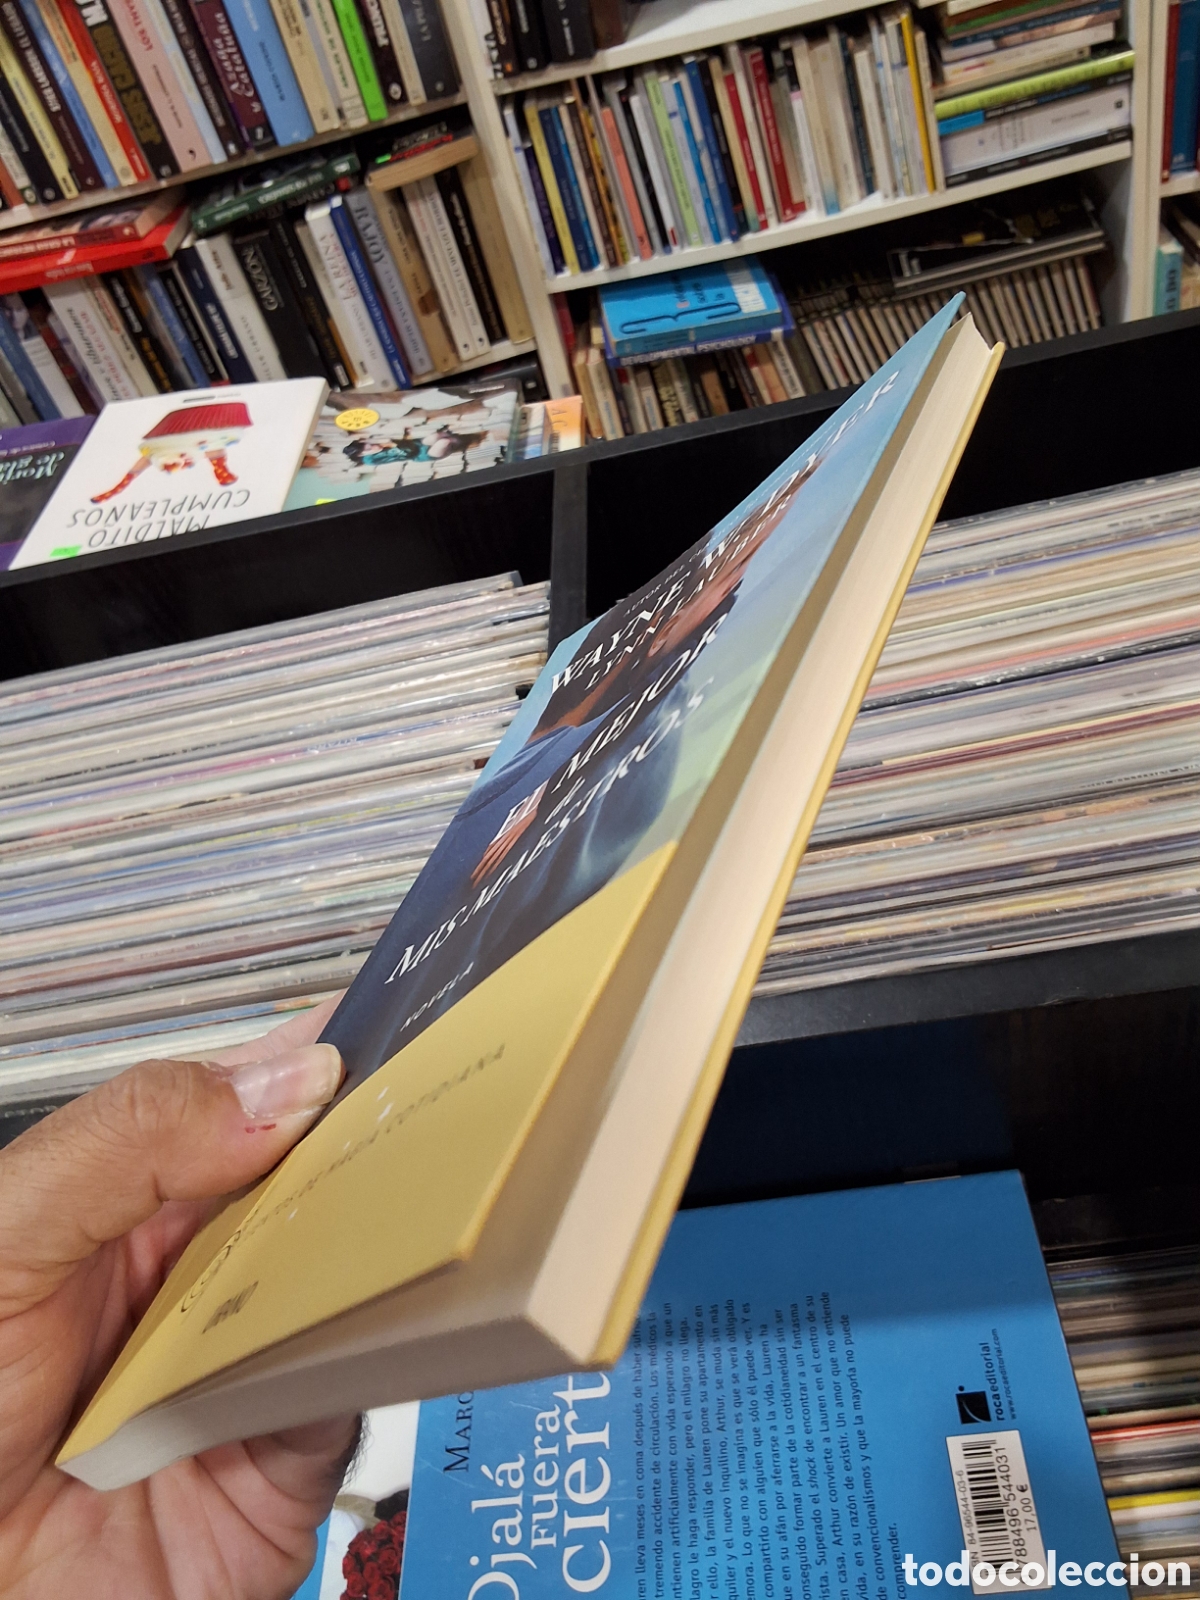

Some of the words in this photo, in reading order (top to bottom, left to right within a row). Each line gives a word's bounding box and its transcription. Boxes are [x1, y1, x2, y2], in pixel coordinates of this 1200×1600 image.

[66, 489, 251, 529] CUMPLEAÑOS
[88, 515, 211, 549] MALDITO
[551, 569, 692, 694] WAYNE
[698, 519, 747, 569] W.
[757, 370, 900, 520] DYER
[585, 614, 662, 691] LYNN
[669, 494, 793, 616] LAUBER
[489, 779, 550, 847] EL
[550, 612, 728, 794] MEJOR
[544, 776, 586, 825] de
[384, 904, 468, 985] MIS
[460, 676, 715, 927] MAESTROS
[400, 962, 474, 1033] NOVELA
[646, 1311, 656, 1321] la
[663, 1302, 671, 1315] un
[708, 1303, 718, 1323] más
[741, 1302, 750, 1313] es
[774, 1309, 783, 1323] ser
[819, 1291, 834, 1336] entiende
[663, 1318, 674, 1337] que
[677, 1316, 690, 1345] llega.
[710, 1327, 720, 1342] sin
[744, 1327, 752, 1346] ver.
[775, 1327, 785, 1342] sin
[790, 1303, 802, 1349] fantasma
[839, 1314, 854, 1345] puede
[646, 1324, 657, 1366] médicos
[681, 1348, 689, 1361] no
[827, 1339, 836, 1353] no
[845, 1349, 854, 1362] no
[711, 1346, 722, 1374] muda
[743, 1349, 758, 1381] puede
[795, 1353, 805, 1367] un
[829, 1356, 841, 1376] que
[992, 1328, 1016, 1420] www.rocaeditorial.com
[648, 1369, 658, 1388] Los
[663, 1350, 676, 1404] esperando
[680, 1365, 692, 1406] milagro
[715, 1378, 723, 1390] se
[746, 1385, 757, 1395] él
[775, 1346, 793, 1420] cotidianeidad
[846, 1366, 862, 1410] mayoría
[798, 1381, 812, 1434] encontrar
[832, 1380, 844, 1407] amor
[648, 1391, 660, 1456] circulación.
[664, 1408, 676, 1431] vida
[681, 1410, 692, 1420] el
[715, 1394, 726, 1432] Arthur,
[747, 1399, 759, 1422] sólo
[835, 1412, 846, 1428] Un
[852, 1414, 864, 1425] la
[684, 1424, 695, 1448] pero
[752, 1426, 763, 1447] que
[784, 1424, 795, 1434] la
[856, 1429, 869, 1450] que
[668, 1435, 677, 1455] con
[785, 1438, 797, 1452] de
[802, 1439, 814, 1452] de
[837, 1432, 852, 1471] existir.
[649, 1460, 660, 1474] de
[717, 1436, 731, 1492] inquilino,
[753, 1451, 767, 1494] alguien
[789, 1456, 802, 1487] parte
[804, 1456, 819, 1489] shock
[996, 1447, 1016, 1501] 544031
[551, 1371, 611, 1592] Ciert
[683, 1453, 697, 1513] responder,
[842, 1475, 854, 1490] de
[1017, 1484, 1028, 1493] €
[650, 1478, 662, 1534] accidente
[667, 1459, 680, 1546] artificialmente
[758, 1499, 768, 1521] con
[792, 1492, 804, 1531] formar
[807, 1493, 819, 1504] el
[845, 1494, 858, 1527] razón
[956, 1470, 976, 1546] 84-96544-03-6
[722, 1497, 732, 1532] nuevo
[865, 1465, 886, 1582] convencionalismos
[1021, 1497, 1037, 1532] 17,00
[686, 1518, 700, 1547] haga
[722, 1537, 734, 1549] el
[810, 1508, 828, 1565] Superado
[852, 1532, 862, 1546] su
[651, 1539, 664, 1598] tremendo
[687, 1552, 698, 1563] le
[726, 1553, 737, 1561] y
[757, 1525, 774, 1598] compartirlo
[854, 1551, 864, 1566] en
[818, 1570, 830, 1600] ista.
[855, 1572, 869, 1600] vida,
[875, 1586, 888, 1600] de
